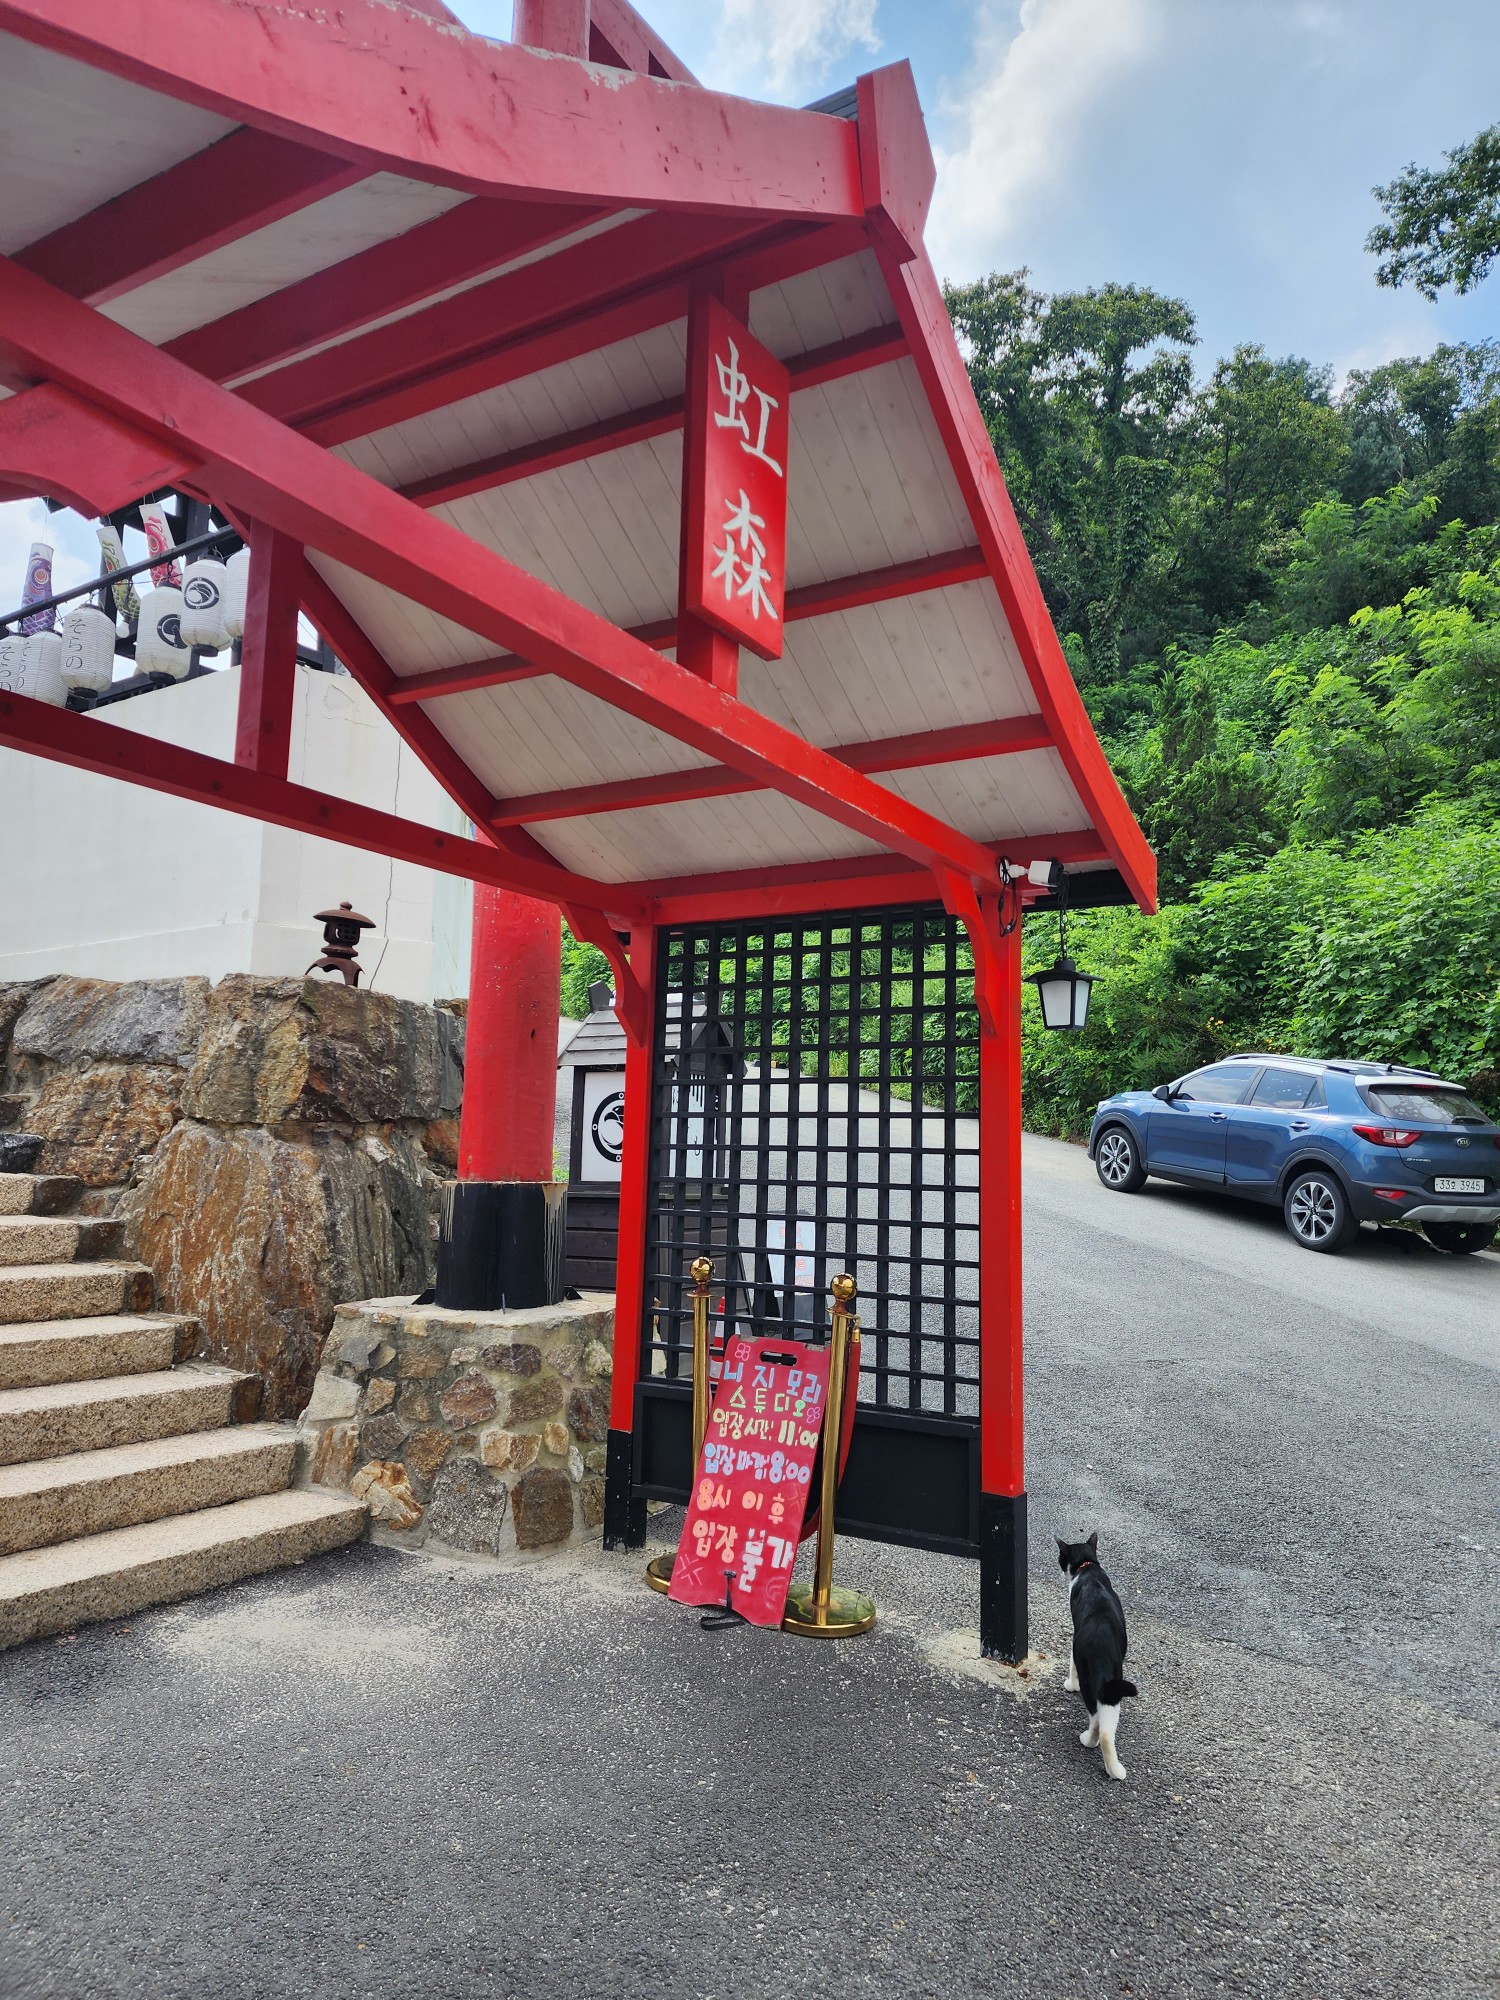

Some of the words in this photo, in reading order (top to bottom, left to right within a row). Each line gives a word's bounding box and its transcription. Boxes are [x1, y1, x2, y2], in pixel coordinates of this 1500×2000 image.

[711, 336, 783, 620] 虹森
[1460, 1181, 1480, 1190] 3945
[778, 1420, 818, 1449] 11:00
[697, 1478, 731, 1511] 8시
[692, 1520, 738, 1563] 입장
[739, 1528, 794, 1593] 불가
